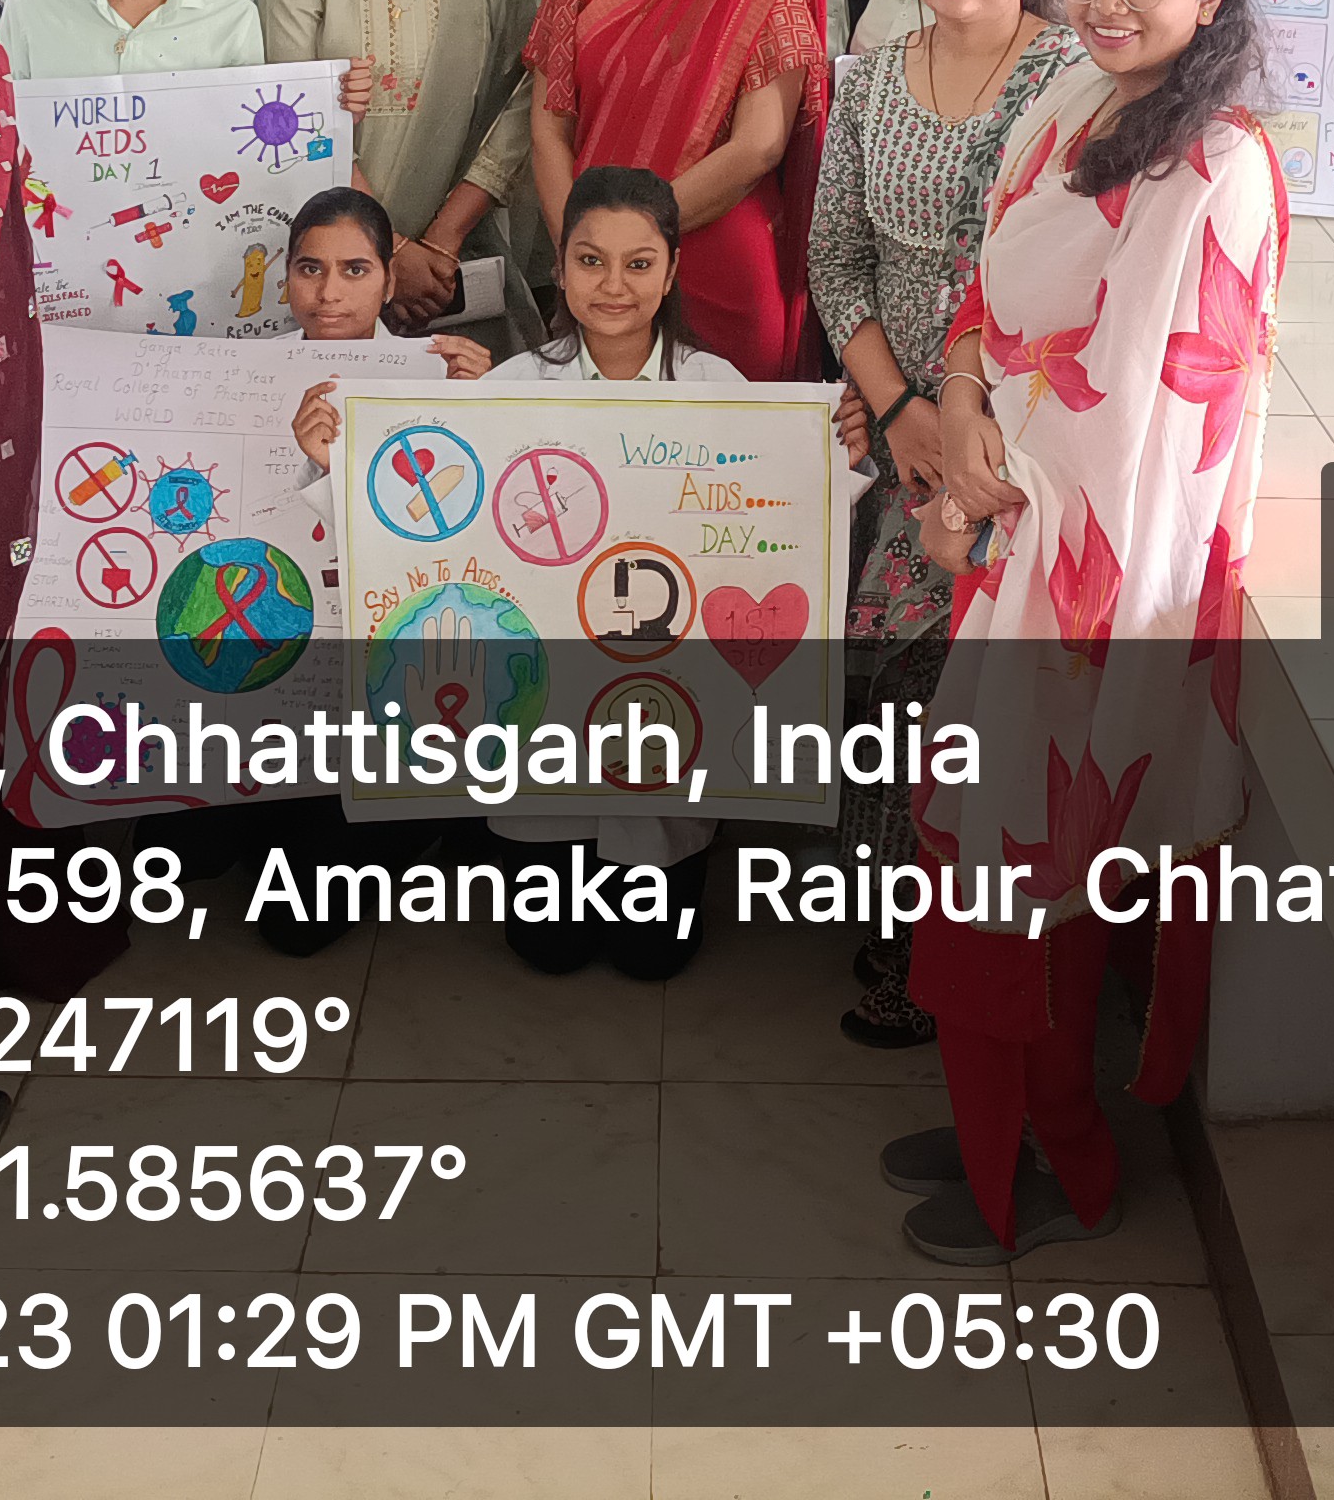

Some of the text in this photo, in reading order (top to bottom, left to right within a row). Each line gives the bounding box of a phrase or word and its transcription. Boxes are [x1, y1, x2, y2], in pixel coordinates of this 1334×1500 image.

[54, 95, 146, 128] WORLD
[76, 129, 147, 157] AIDS
[92, 158, 162, 182] DAY 1
[225, 211, 241, 224] AM
[243, 204, 264, 215] THE
[42, 308, 92, 322] DISEASED
[226, 319, 279, 340] REDUCE
[134, 338, 181, 365] Ganga
[378, 351, 409, 366] 2023
[51, 373, 287, 411] Royal College of Pharmacy
[114, 408, 284, 427] WORLD AIDS DAY
[269, 446, 295, 459] HIV
[264, 463, 299, 475] TEST
[31, 574, 58, 585] STOP
[26, 594, 81, 611] SHARING
[94, 629, 122, 638] HIV
